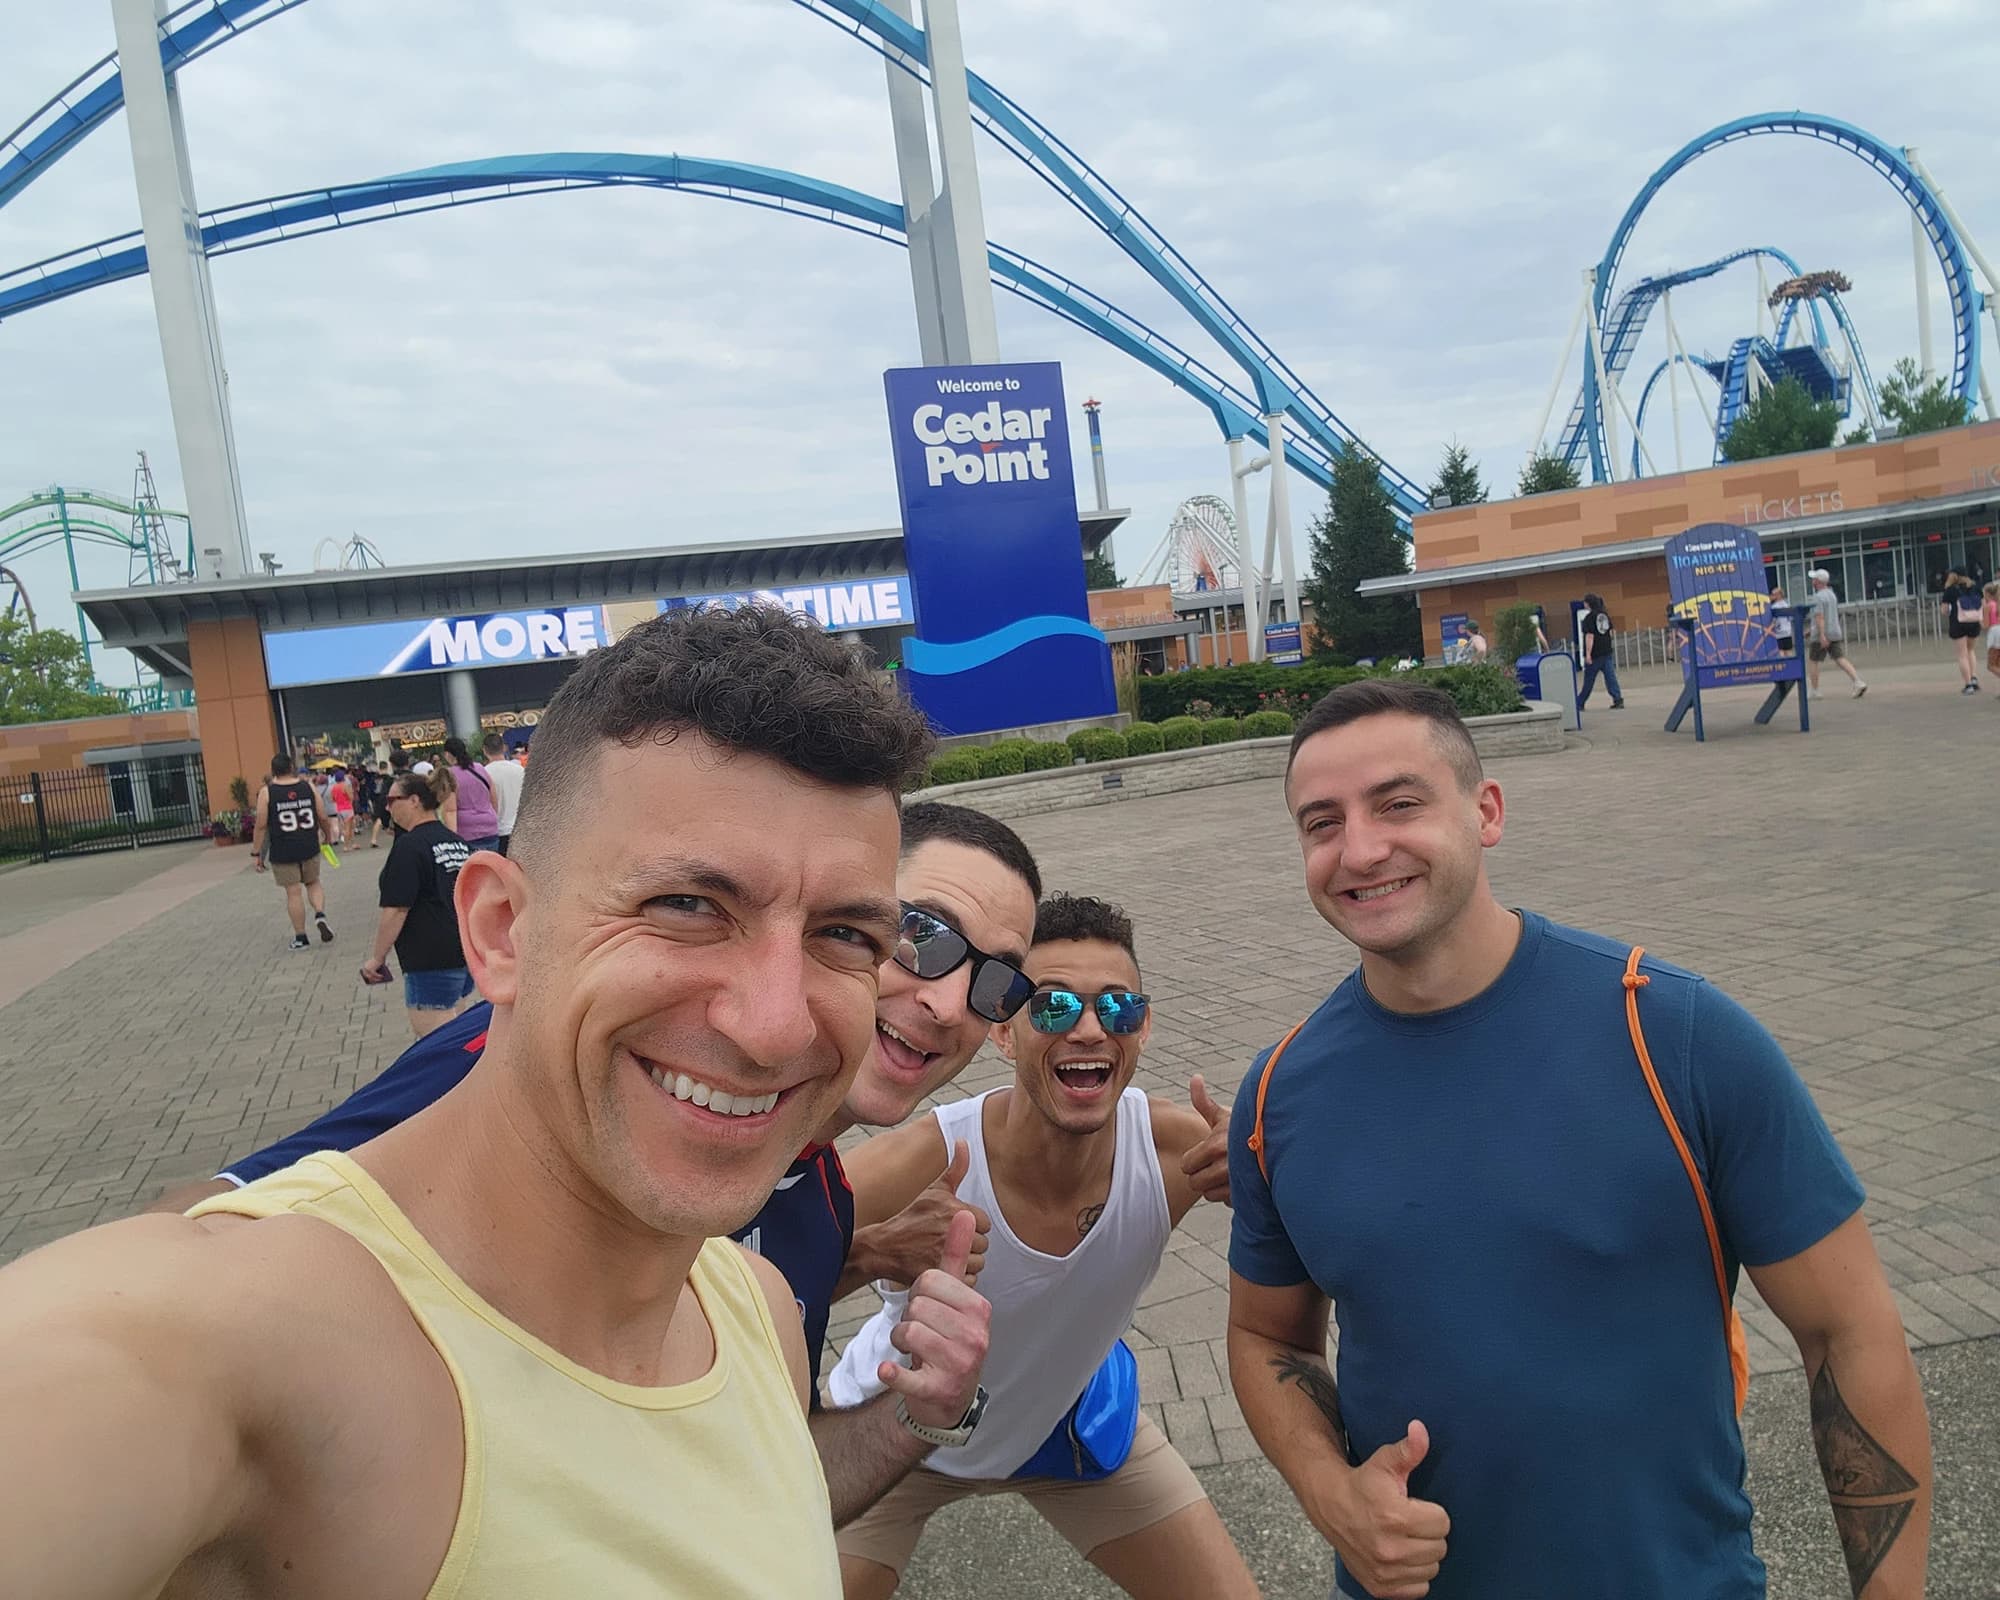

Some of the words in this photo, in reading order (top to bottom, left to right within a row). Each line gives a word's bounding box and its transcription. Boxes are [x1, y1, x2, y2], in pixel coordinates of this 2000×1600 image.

[937, 379, 1003, 394] Welcome
[1005, 378, 1021, 391] to
[912, 401, 1051, 446] Cedar
[924, 442, 1050, 487] Point
[1743, 490, 1844, 524] TICKETS
[1695, 563, 1736, 577] NIGHTS
[430, 610, 598, 666] MORE
[279, 808, 314, 832] 93
